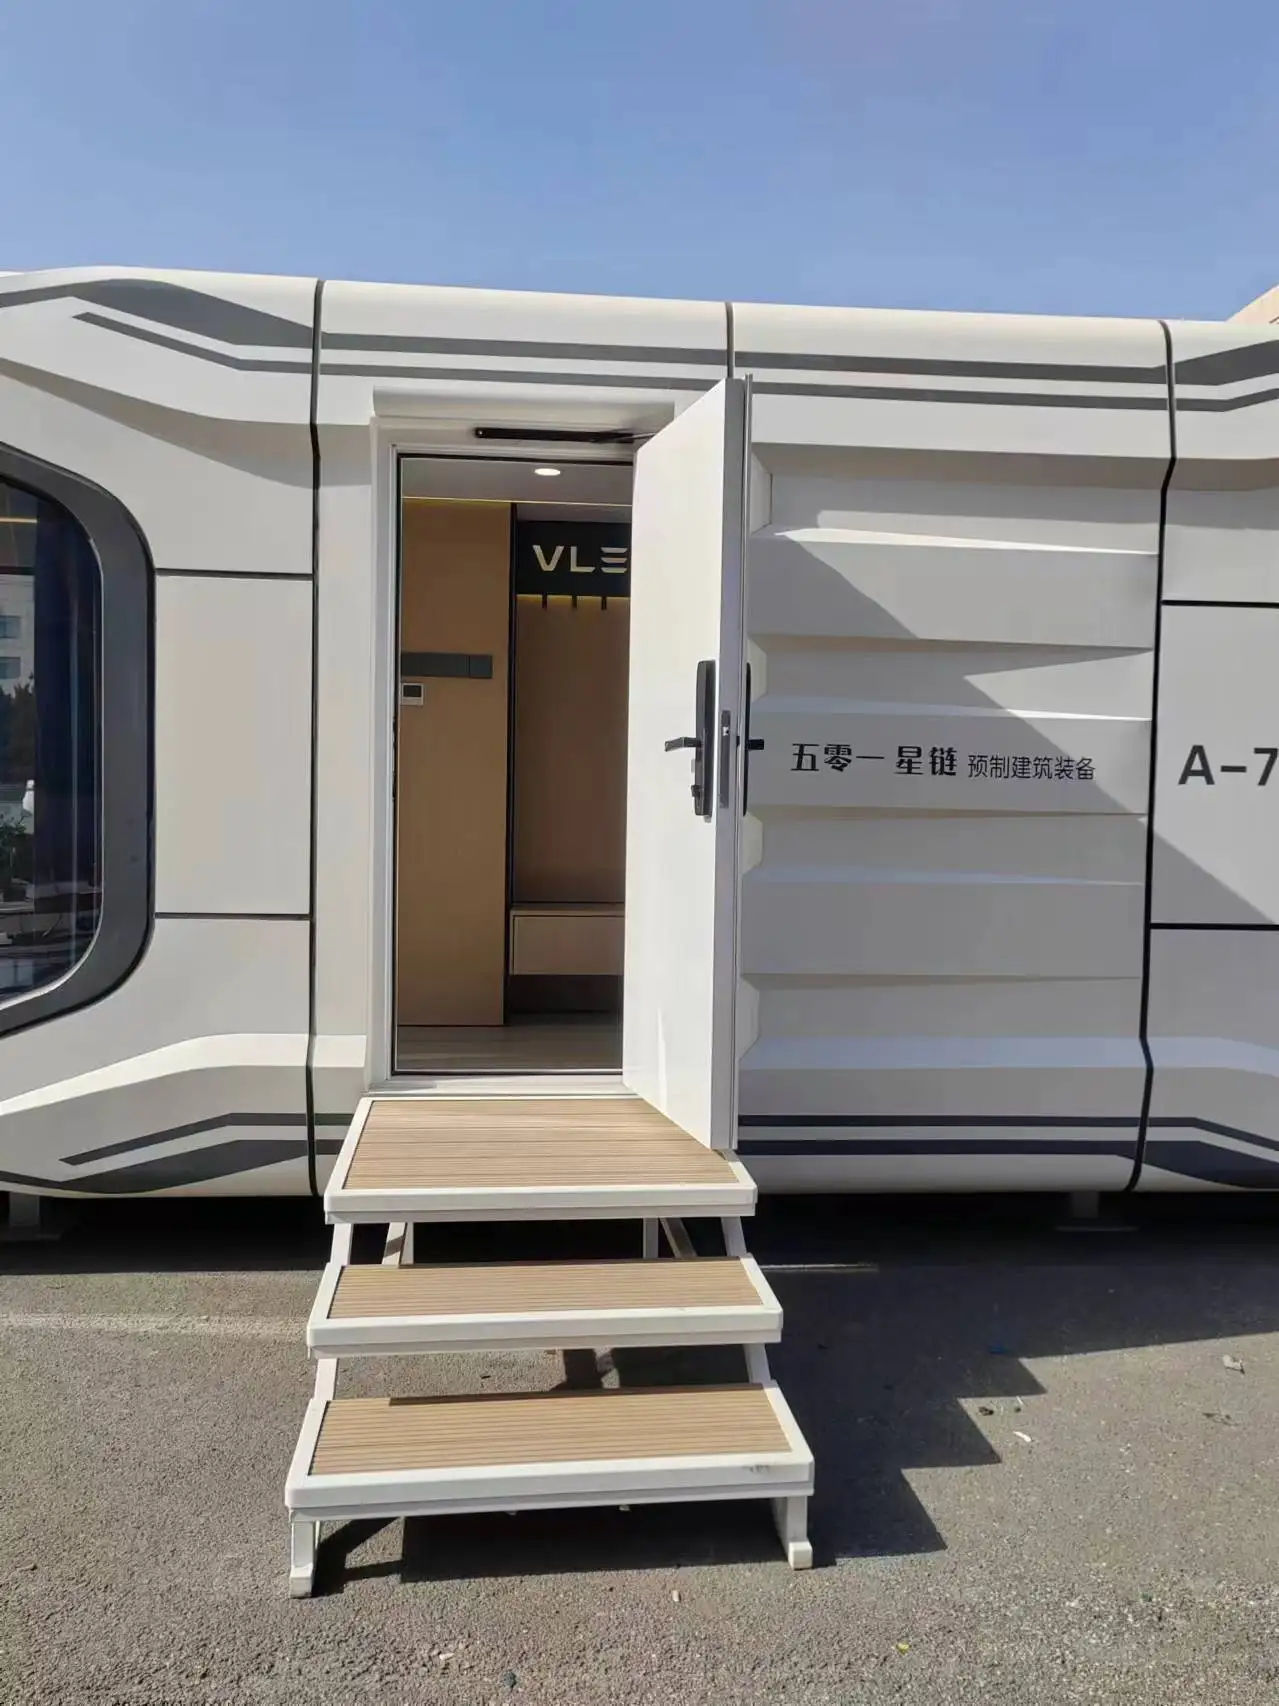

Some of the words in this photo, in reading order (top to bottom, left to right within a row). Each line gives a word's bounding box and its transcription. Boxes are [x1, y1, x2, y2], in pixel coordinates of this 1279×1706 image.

[967, 754, 1096, 780] 预制建筑装备
[1178, 744, 1279, 786] A-7
